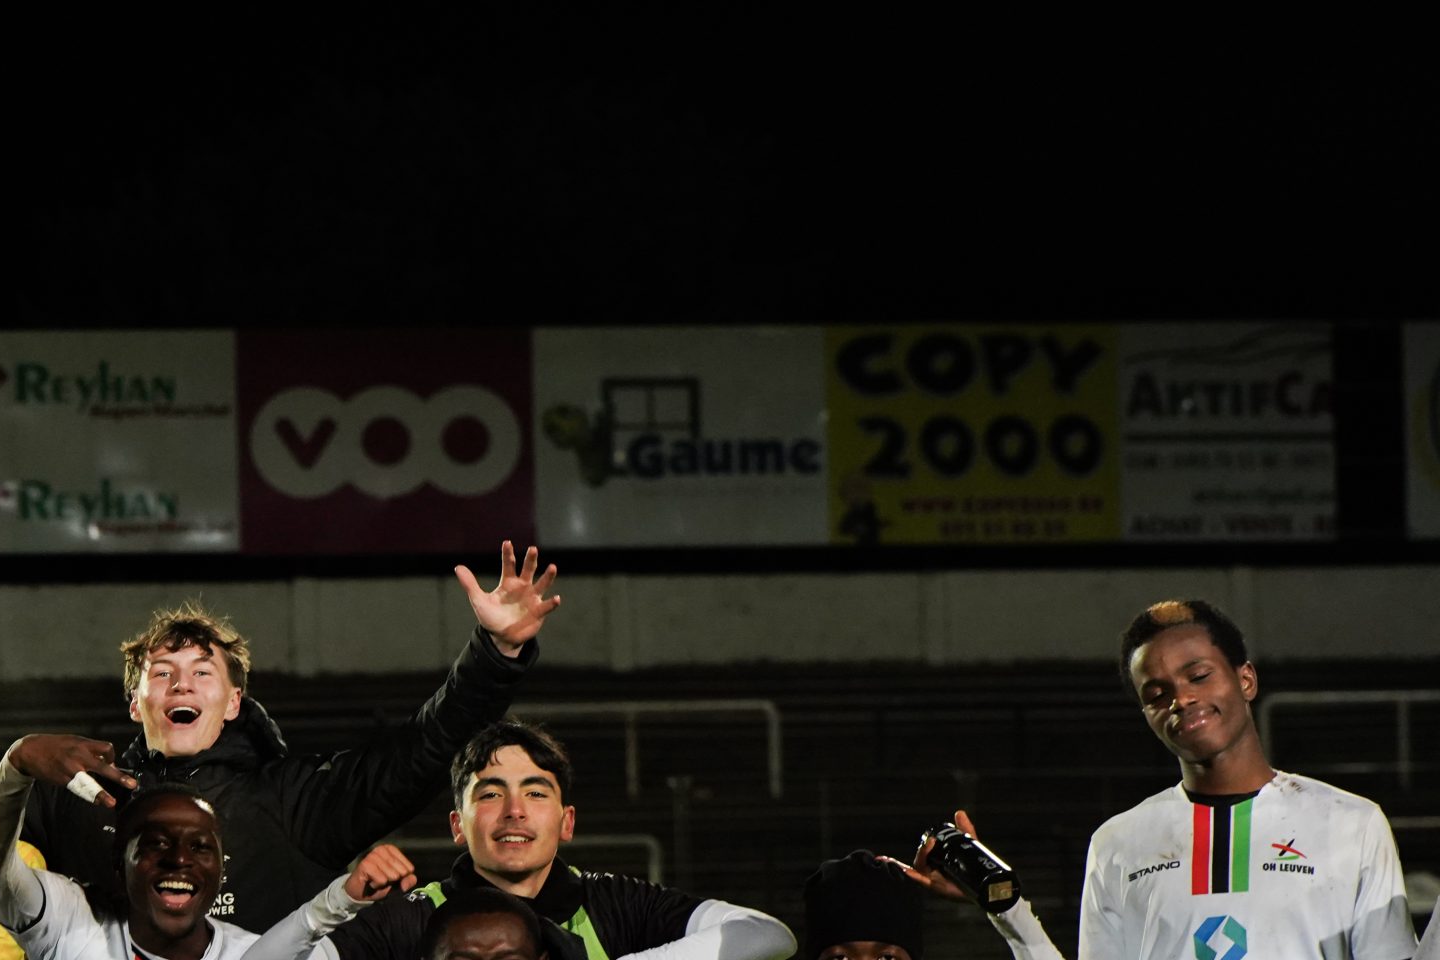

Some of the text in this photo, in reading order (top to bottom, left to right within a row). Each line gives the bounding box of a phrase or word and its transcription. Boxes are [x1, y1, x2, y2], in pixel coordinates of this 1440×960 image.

[837, 334, 1103, 395] COPY
[628, 434, 822, 479] Gaume
[859, 414, 1102, 476] 2000
[1128, 860, 1181, 883] STANNO
[1262, 862, 1315, 876] OH LEUVEN
